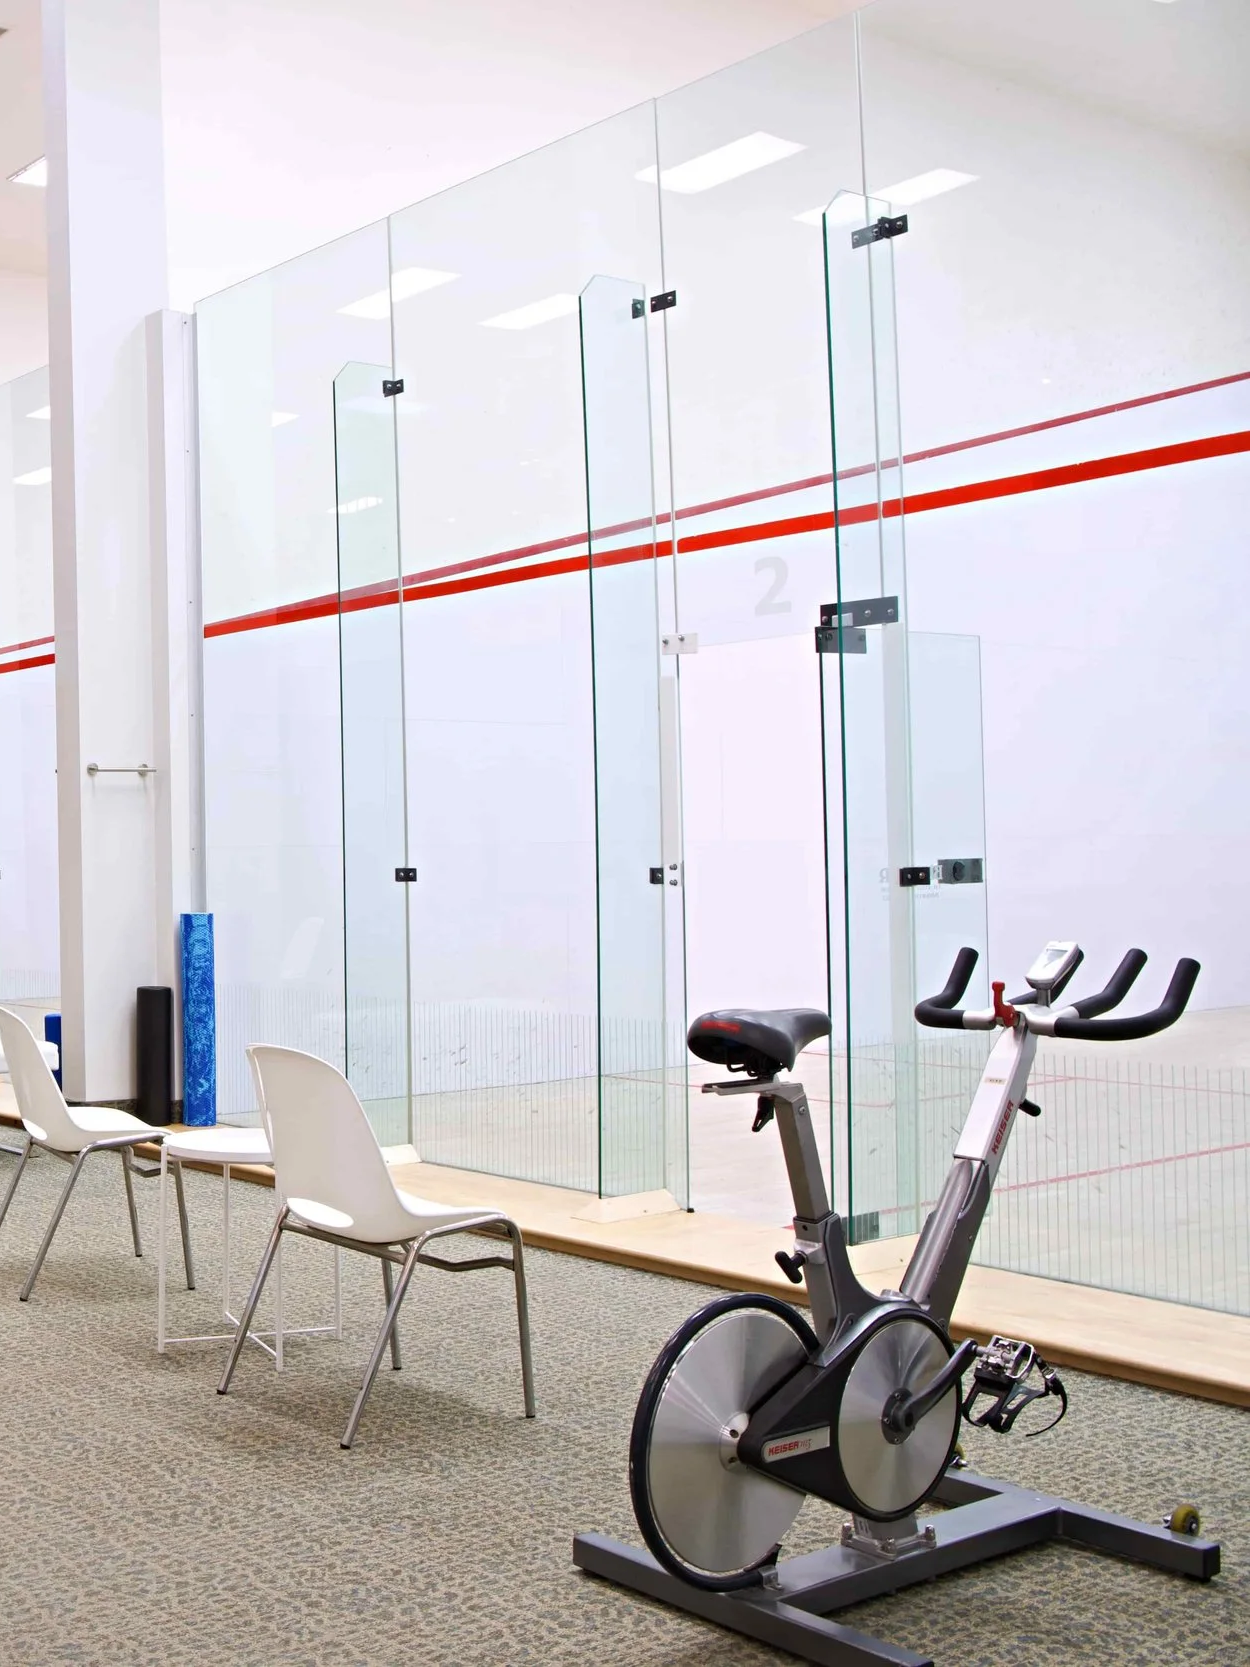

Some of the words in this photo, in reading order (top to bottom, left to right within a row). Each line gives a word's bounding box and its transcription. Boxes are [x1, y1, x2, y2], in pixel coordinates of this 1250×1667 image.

[754, 556, 792, 617] 2
[991, 1100, 1014, 1155] KEISER
[767, 1440, 800, 1457] KEISER
